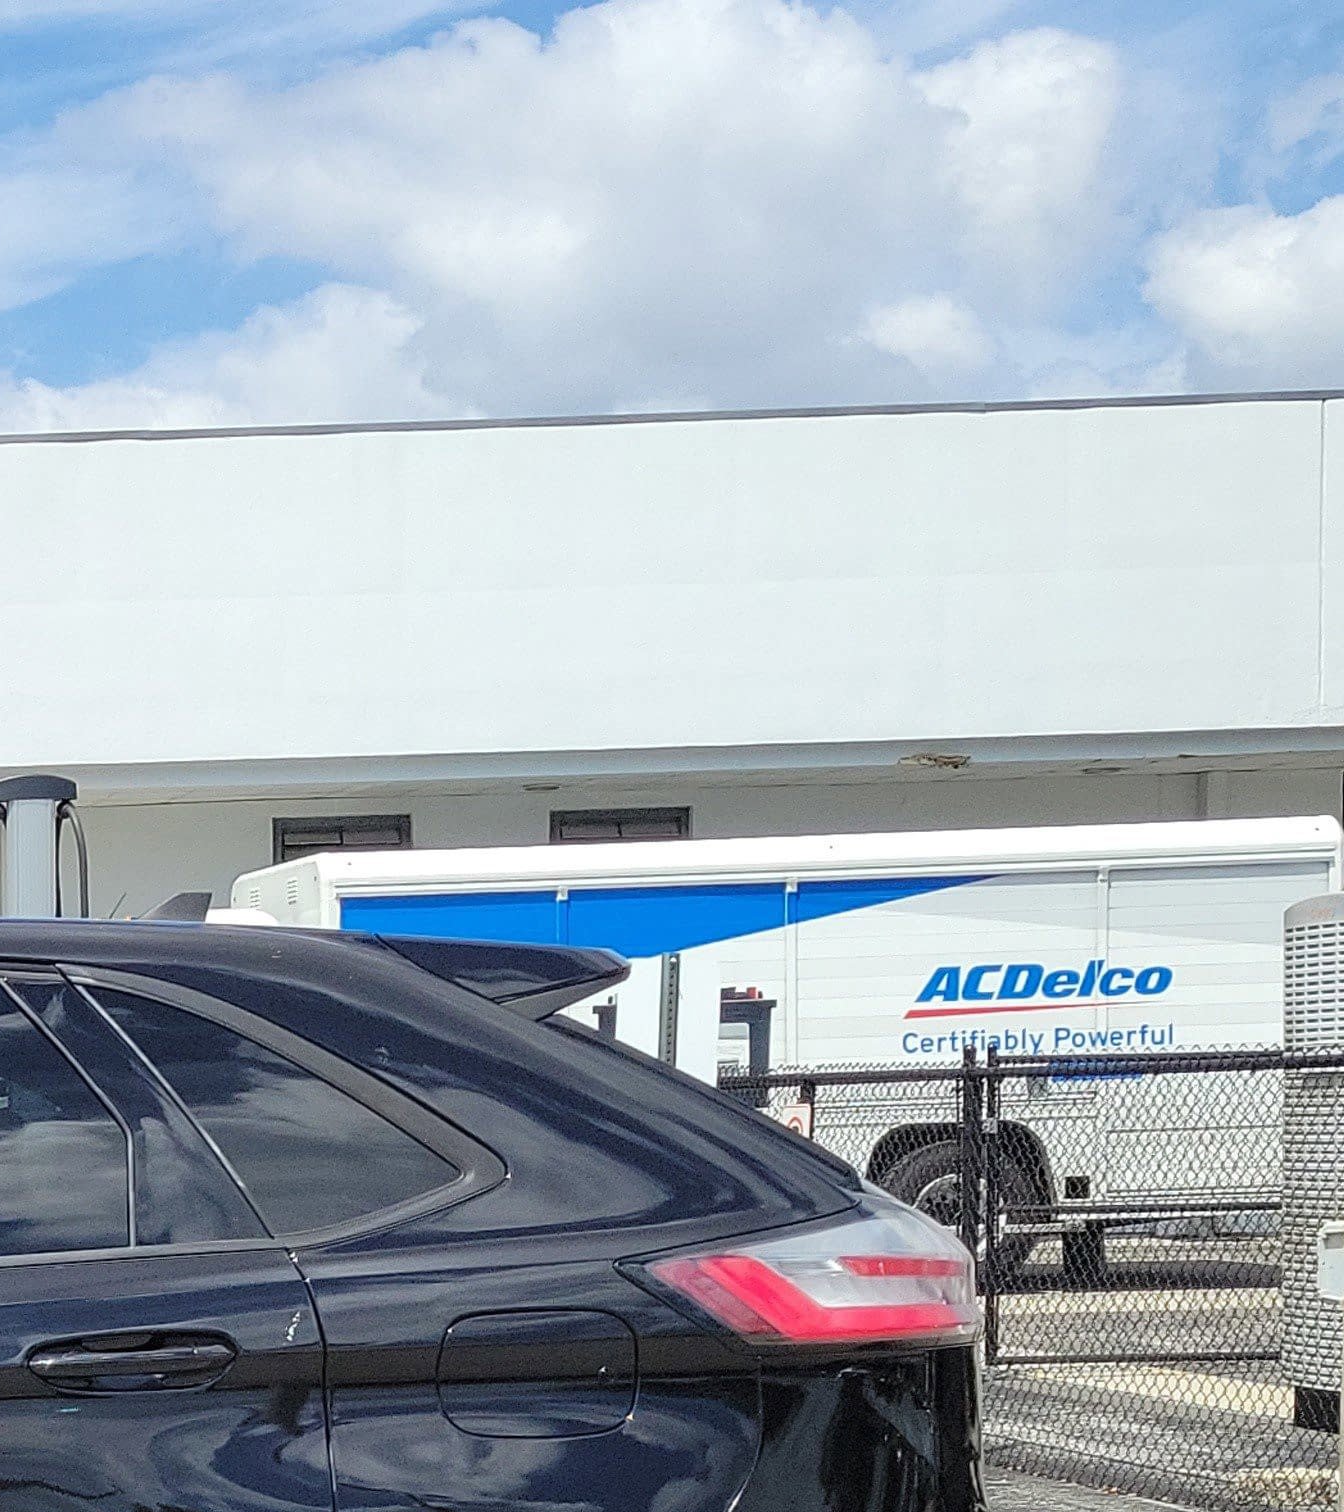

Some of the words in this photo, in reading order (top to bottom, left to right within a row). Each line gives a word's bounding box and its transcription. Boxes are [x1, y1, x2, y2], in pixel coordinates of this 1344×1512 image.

[914, 959, 1173, 1002] ACDelco
[902, 1029, 1044, 1055] Certifiably
[1054, 1023, 1174, 1048] Powerful
